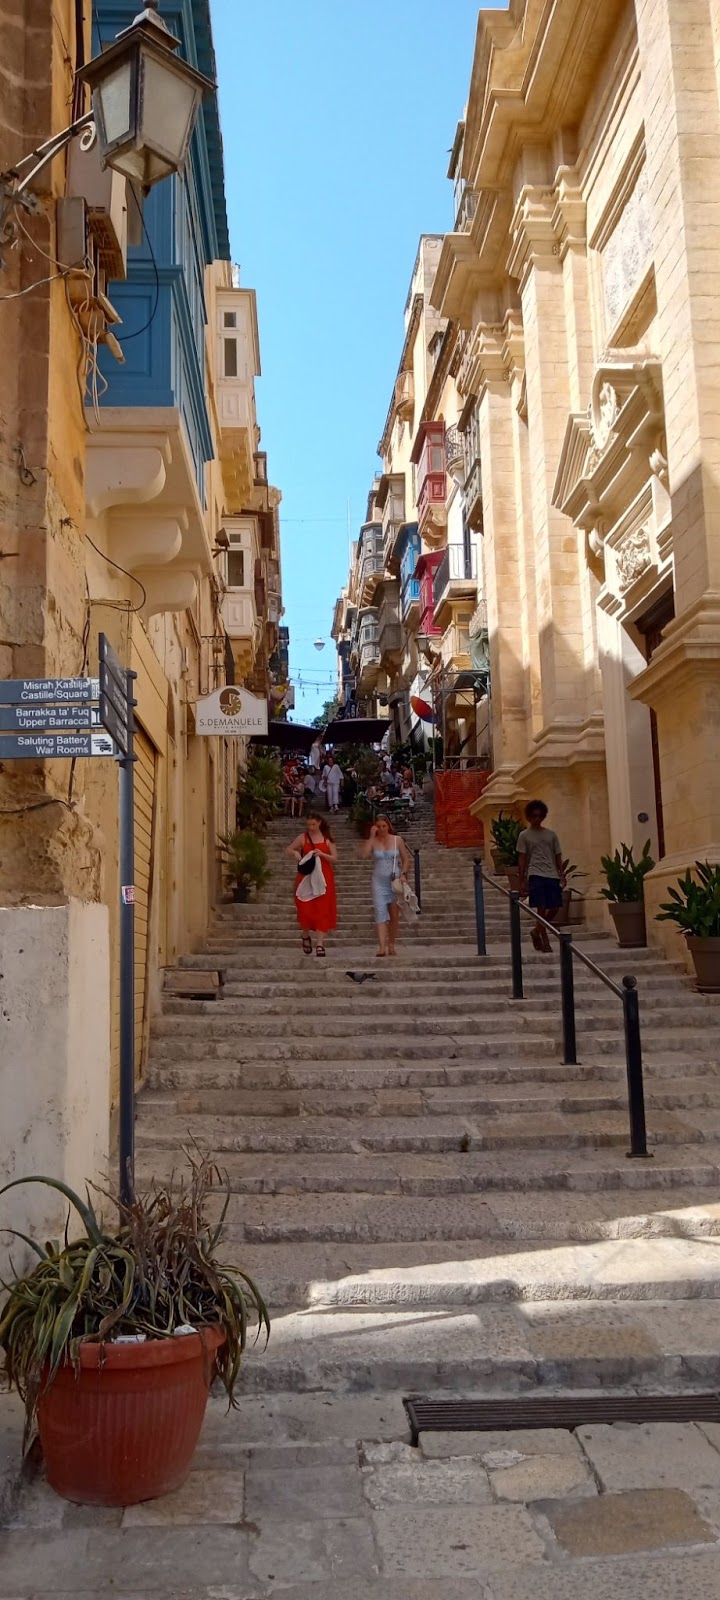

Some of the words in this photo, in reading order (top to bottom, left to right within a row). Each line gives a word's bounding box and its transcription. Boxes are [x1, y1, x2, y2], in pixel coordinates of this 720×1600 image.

[56, 681, 88, 690] Kastilja
[21, 691, 53, 699] Castille
[56, 690, 89, 700] Square
[16, 708, 56, 717] Barrakka
[58, 708, 70, 716] ta'
[71, 708, 89, 718] Fuq
[18, 718, 46, 727] Upper
[49, 717, 89, 726] Barracca
[17, 737, 54, 746] Saluting
[56, 736, 89, 746] Battery
[36, 746, 54, 754] War
[57, 746, 89, 754] Rooms
